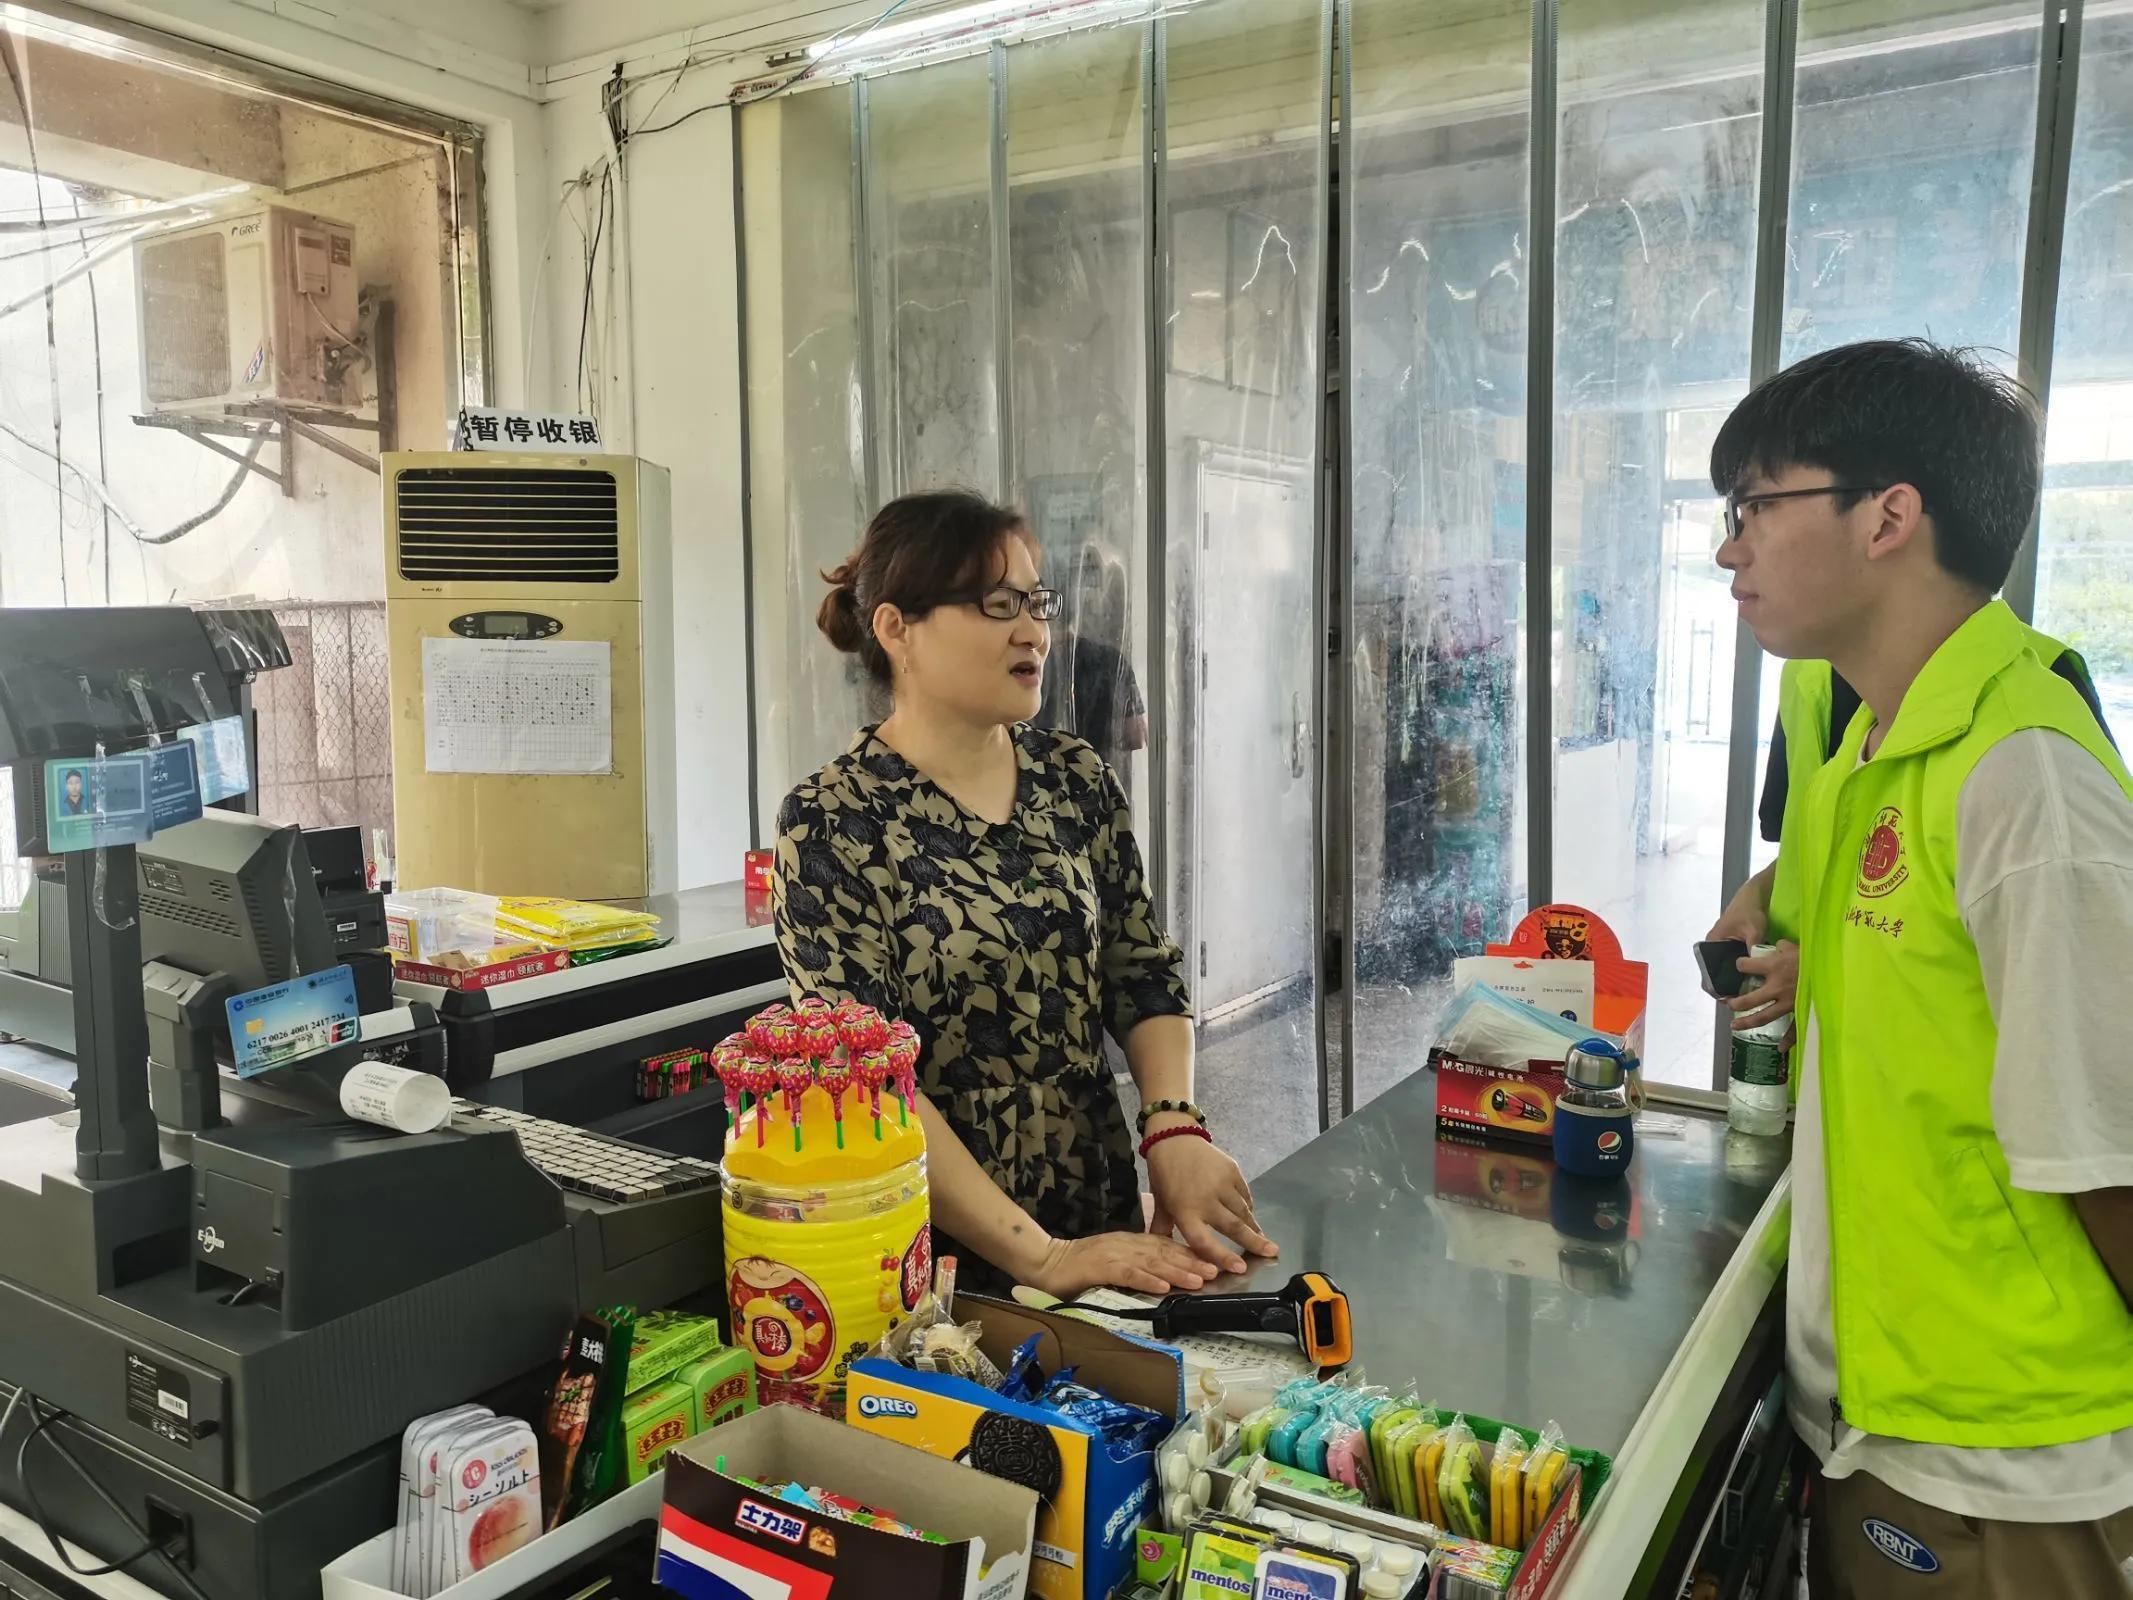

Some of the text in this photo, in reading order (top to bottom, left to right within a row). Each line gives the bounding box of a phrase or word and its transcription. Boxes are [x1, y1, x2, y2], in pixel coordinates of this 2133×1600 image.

[239, 221, 262, 236] GREE
[470, 415, 598, 444] 暂停收银
[1872, 864, 1907, 893] UNIVERSITY
[402, 968, 428, 983] 迷你湿巾
[480, 961, 545, 986] 迷你湿巾 领航者
[247, 1037, 267, 1050] 6217
[268, 1031, 289, 1042] 0026
[290, 1024, 309, 1035] 4001
[311, 1017, 330, 1030] 2417
[861, 1396, 917, 1416] OREO
[469, 1469, 530, 1507] シーソルト
[741, 1504, 802, 1540] 士力架
[1873, 1524, 1918, 1560] RBNT
[1190, 1568, 1251, 1594] mentos
